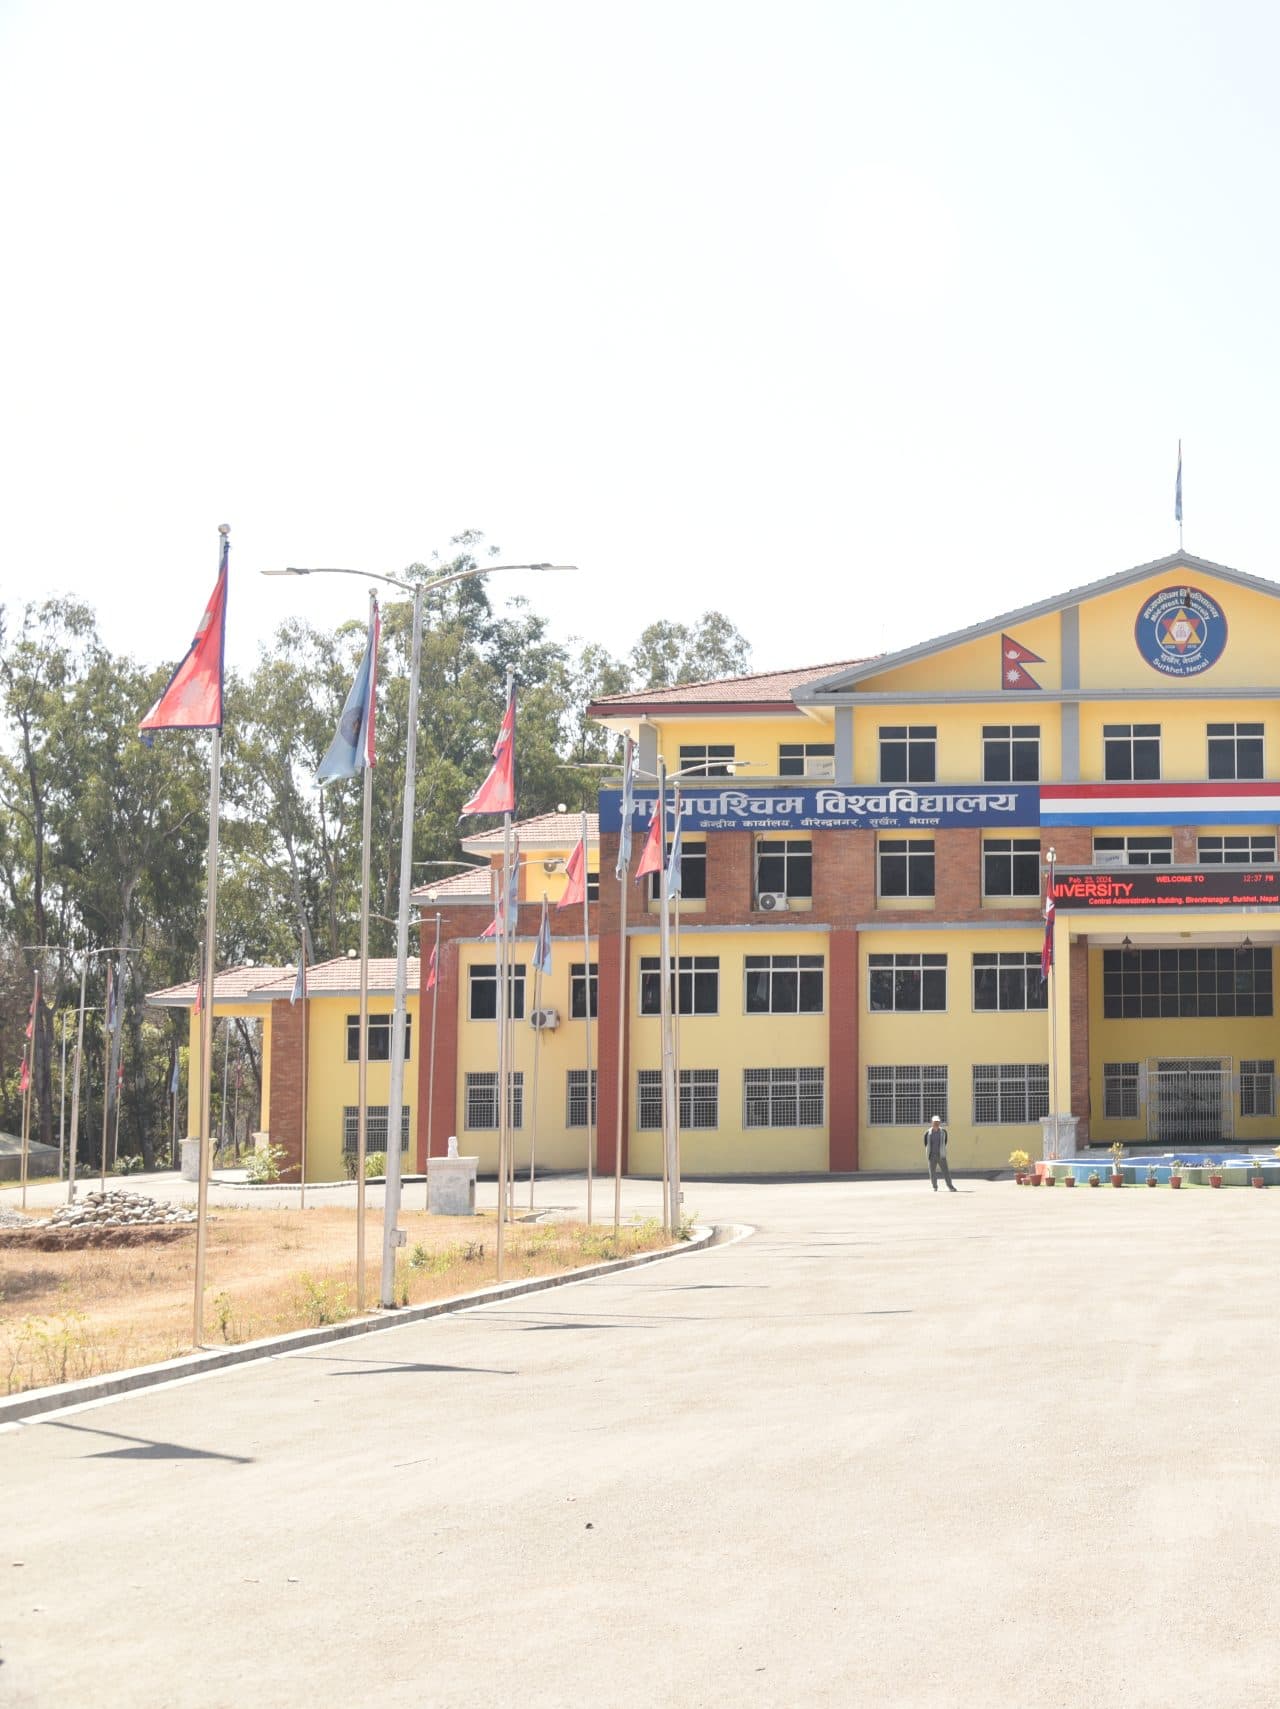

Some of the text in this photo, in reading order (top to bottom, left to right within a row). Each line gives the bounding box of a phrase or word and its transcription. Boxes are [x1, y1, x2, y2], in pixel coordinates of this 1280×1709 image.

[1186, 658, 1210, 674] Nepal
[815, 789, 1018, 814] विश्वविद्यालय
[1194, 875, 1205, 883] TO
